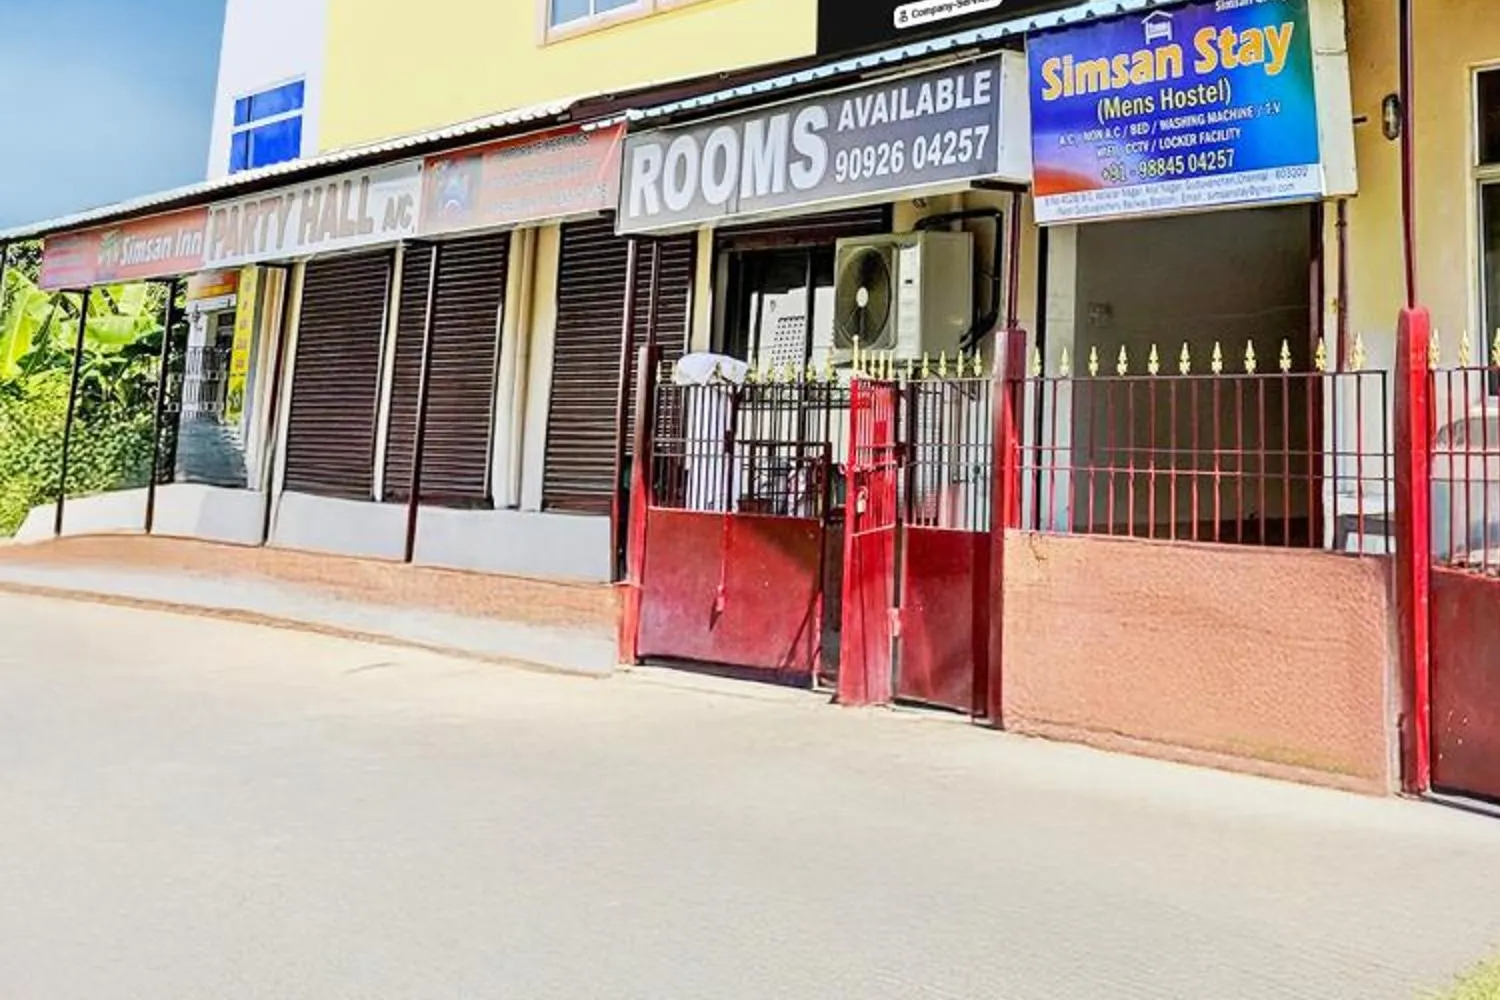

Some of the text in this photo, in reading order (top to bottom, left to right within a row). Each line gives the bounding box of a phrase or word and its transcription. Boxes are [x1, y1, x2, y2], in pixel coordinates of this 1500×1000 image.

[1041, 21, 1294, 101] Simsan Stay
[838, 69, 992, 132] AVAILABLE
[1097, 78, 1232, 125] (Mens Hostel)
[1159, 112, 1206, 131] WASHING
[1207, 104, 1254, 125] MACHINE
[629, 104, 830, 217] ROOMS
[835, 124, 990, 184] 90926 04257
[1138, 154, 1185, 179] 98845
[1188, 148, 1236, 173] 04257
[1159, 133, 1197, 151] LOCKER
[1199, 126, 1242, 145] FACILITY
[176, 227, 202, 258] Inn
[209, 193, 295, 261] PARTY
[298, 174, 374, 246] HALL
